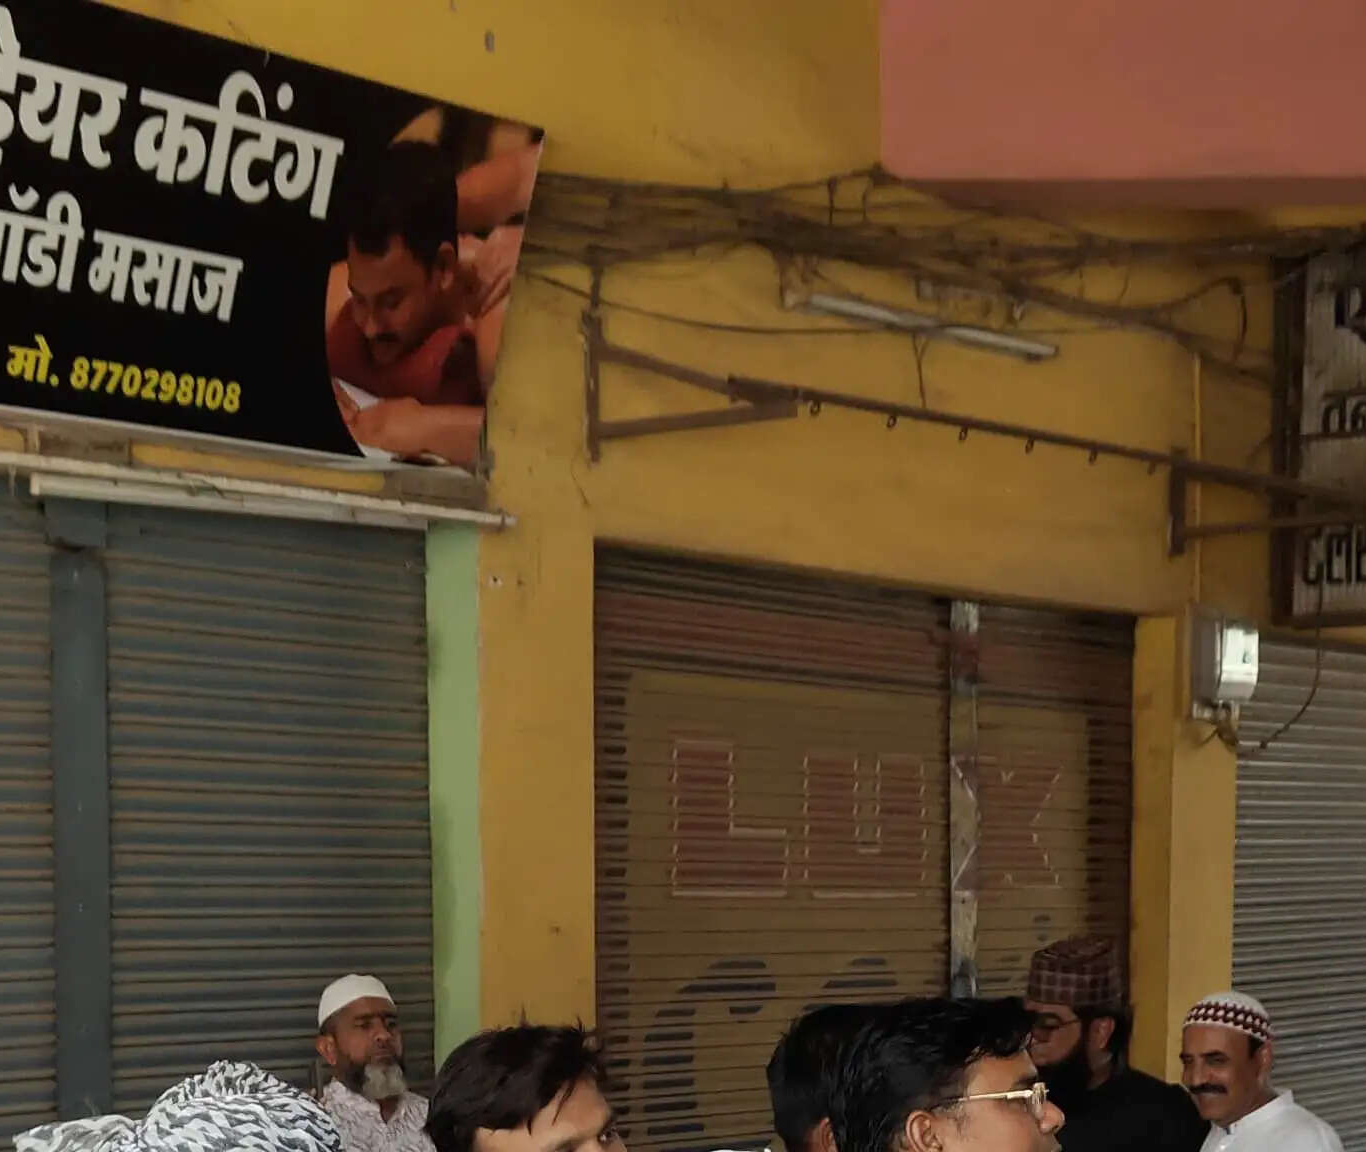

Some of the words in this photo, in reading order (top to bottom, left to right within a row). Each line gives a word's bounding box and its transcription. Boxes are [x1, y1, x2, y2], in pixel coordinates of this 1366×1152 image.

[134, 70, 345, 219] कटिंग
[88, 228, 244, 323] मसाज
[6, 334, 60, 388] मो.
[70, 356, 241, 414] 8770298108
[670, 737, 1065, 898] LUX
